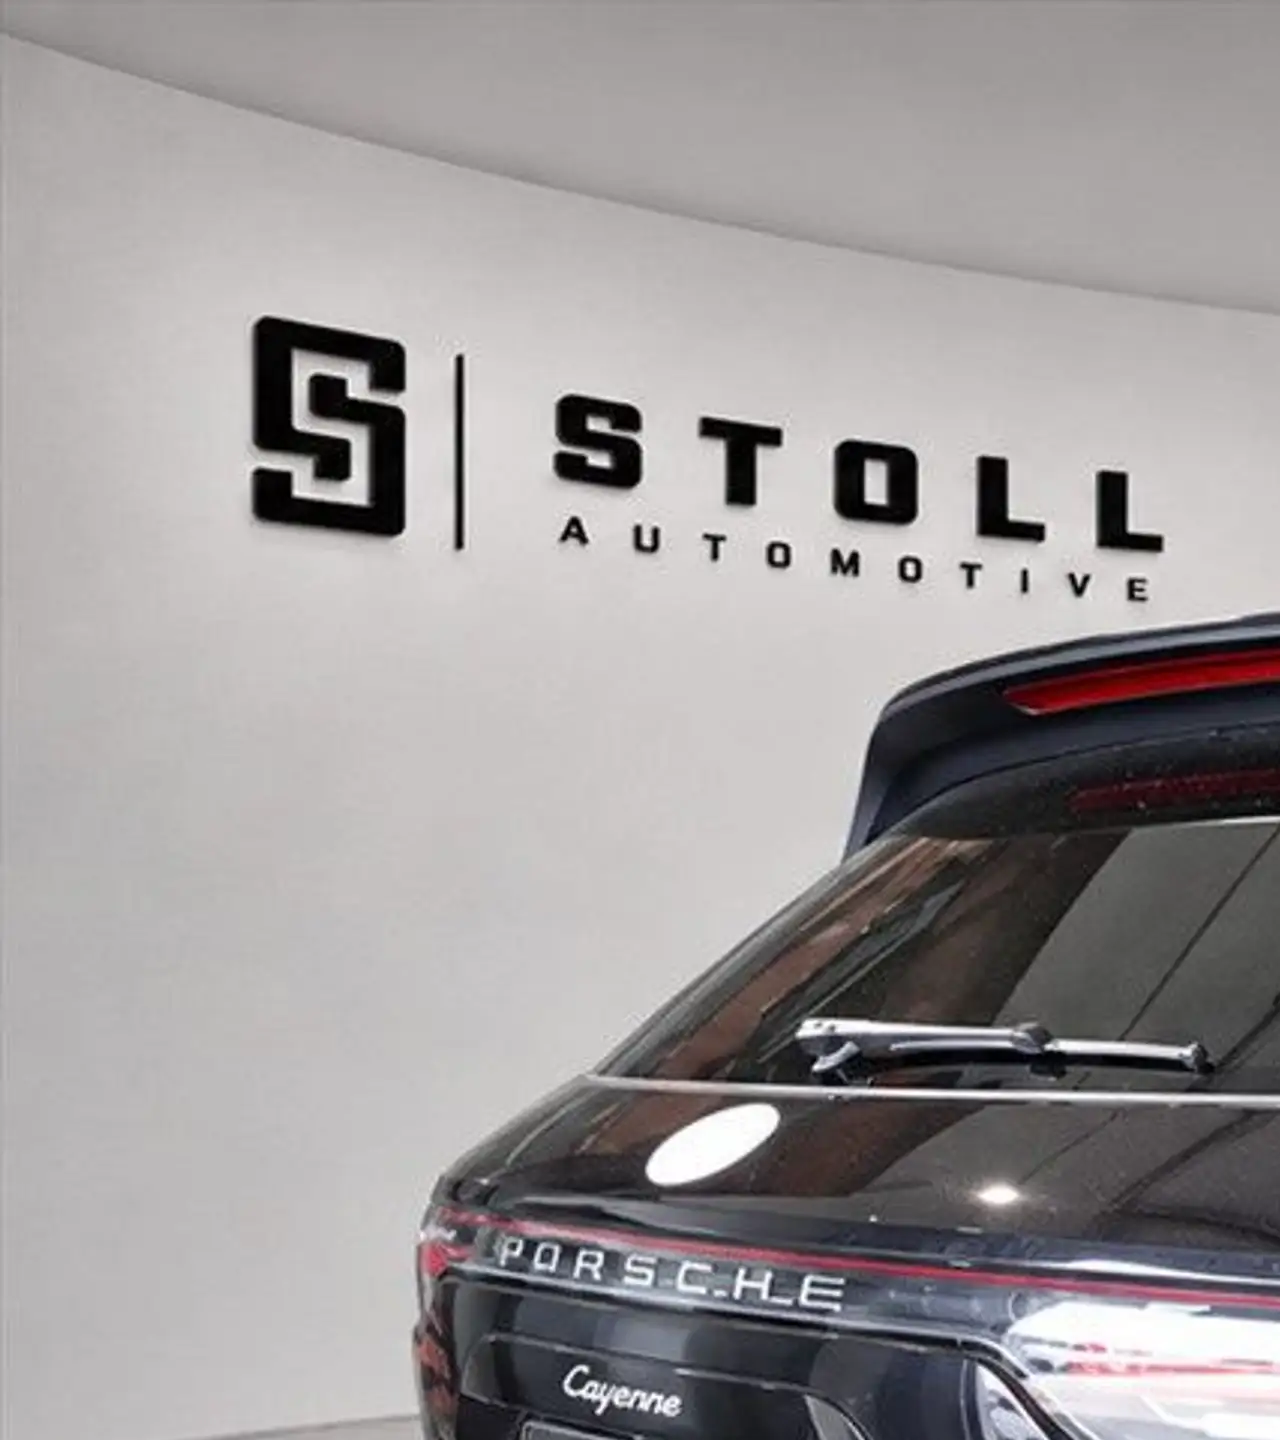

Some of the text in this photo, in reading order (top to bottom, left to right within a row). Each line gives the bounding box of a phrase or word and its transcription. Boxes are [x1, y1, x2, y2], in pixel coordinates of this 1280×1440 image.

[553, 393, 1165, 554] STOLL
[558, 515, 1150, 603] AUTOMOTIVE
[496, 1235, 846, 1313] PORSCHE
[562, 1363, 683, 1418] Cayenne
